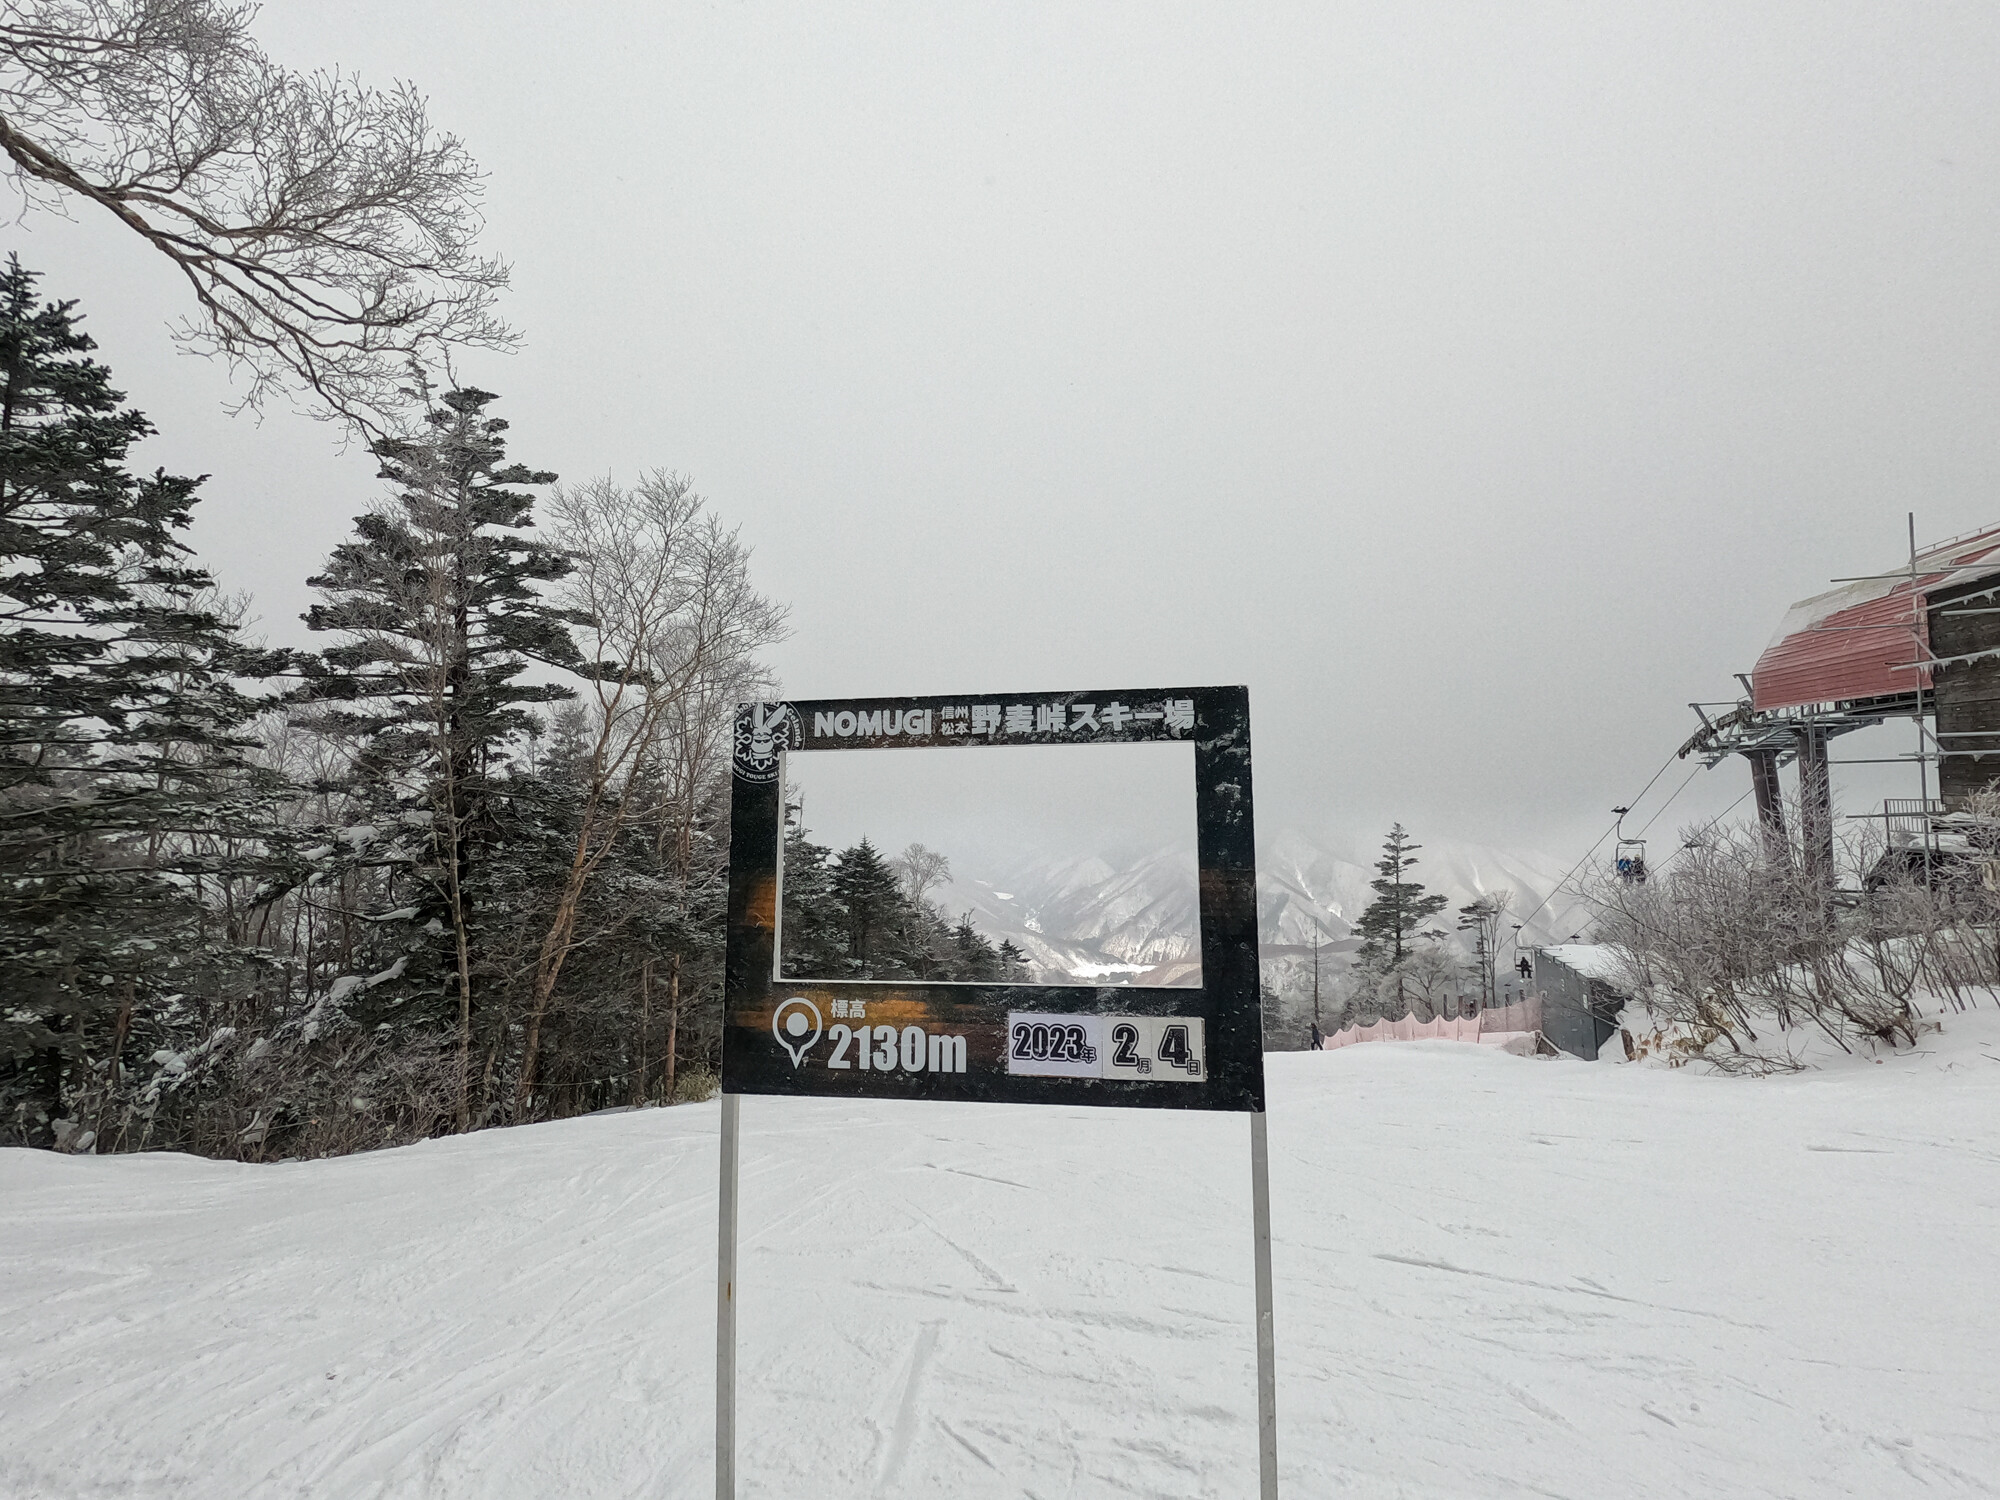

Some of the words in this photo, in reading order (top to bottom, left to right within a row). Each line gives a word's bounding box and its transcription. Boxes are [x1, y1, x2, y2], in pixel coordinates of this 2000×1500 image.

[814, 709, 932, 737] NOMUGI
[940, 706, 969, 720] 信州
[971, 699, 1196, 734] 野麦峠スキー場
[940, 721, 969, 735] 松本
[746, 772, 766, 780] TOUGE
[830, 998, 866, 1019] 標高
[827, 1023, 967, 1074] 2130m
[1012, 1022, 1097, 1064] 2023年
[1112, 1023, 1152, 1074] 2月
[1157, 1025, 1201, 1076] 4日
